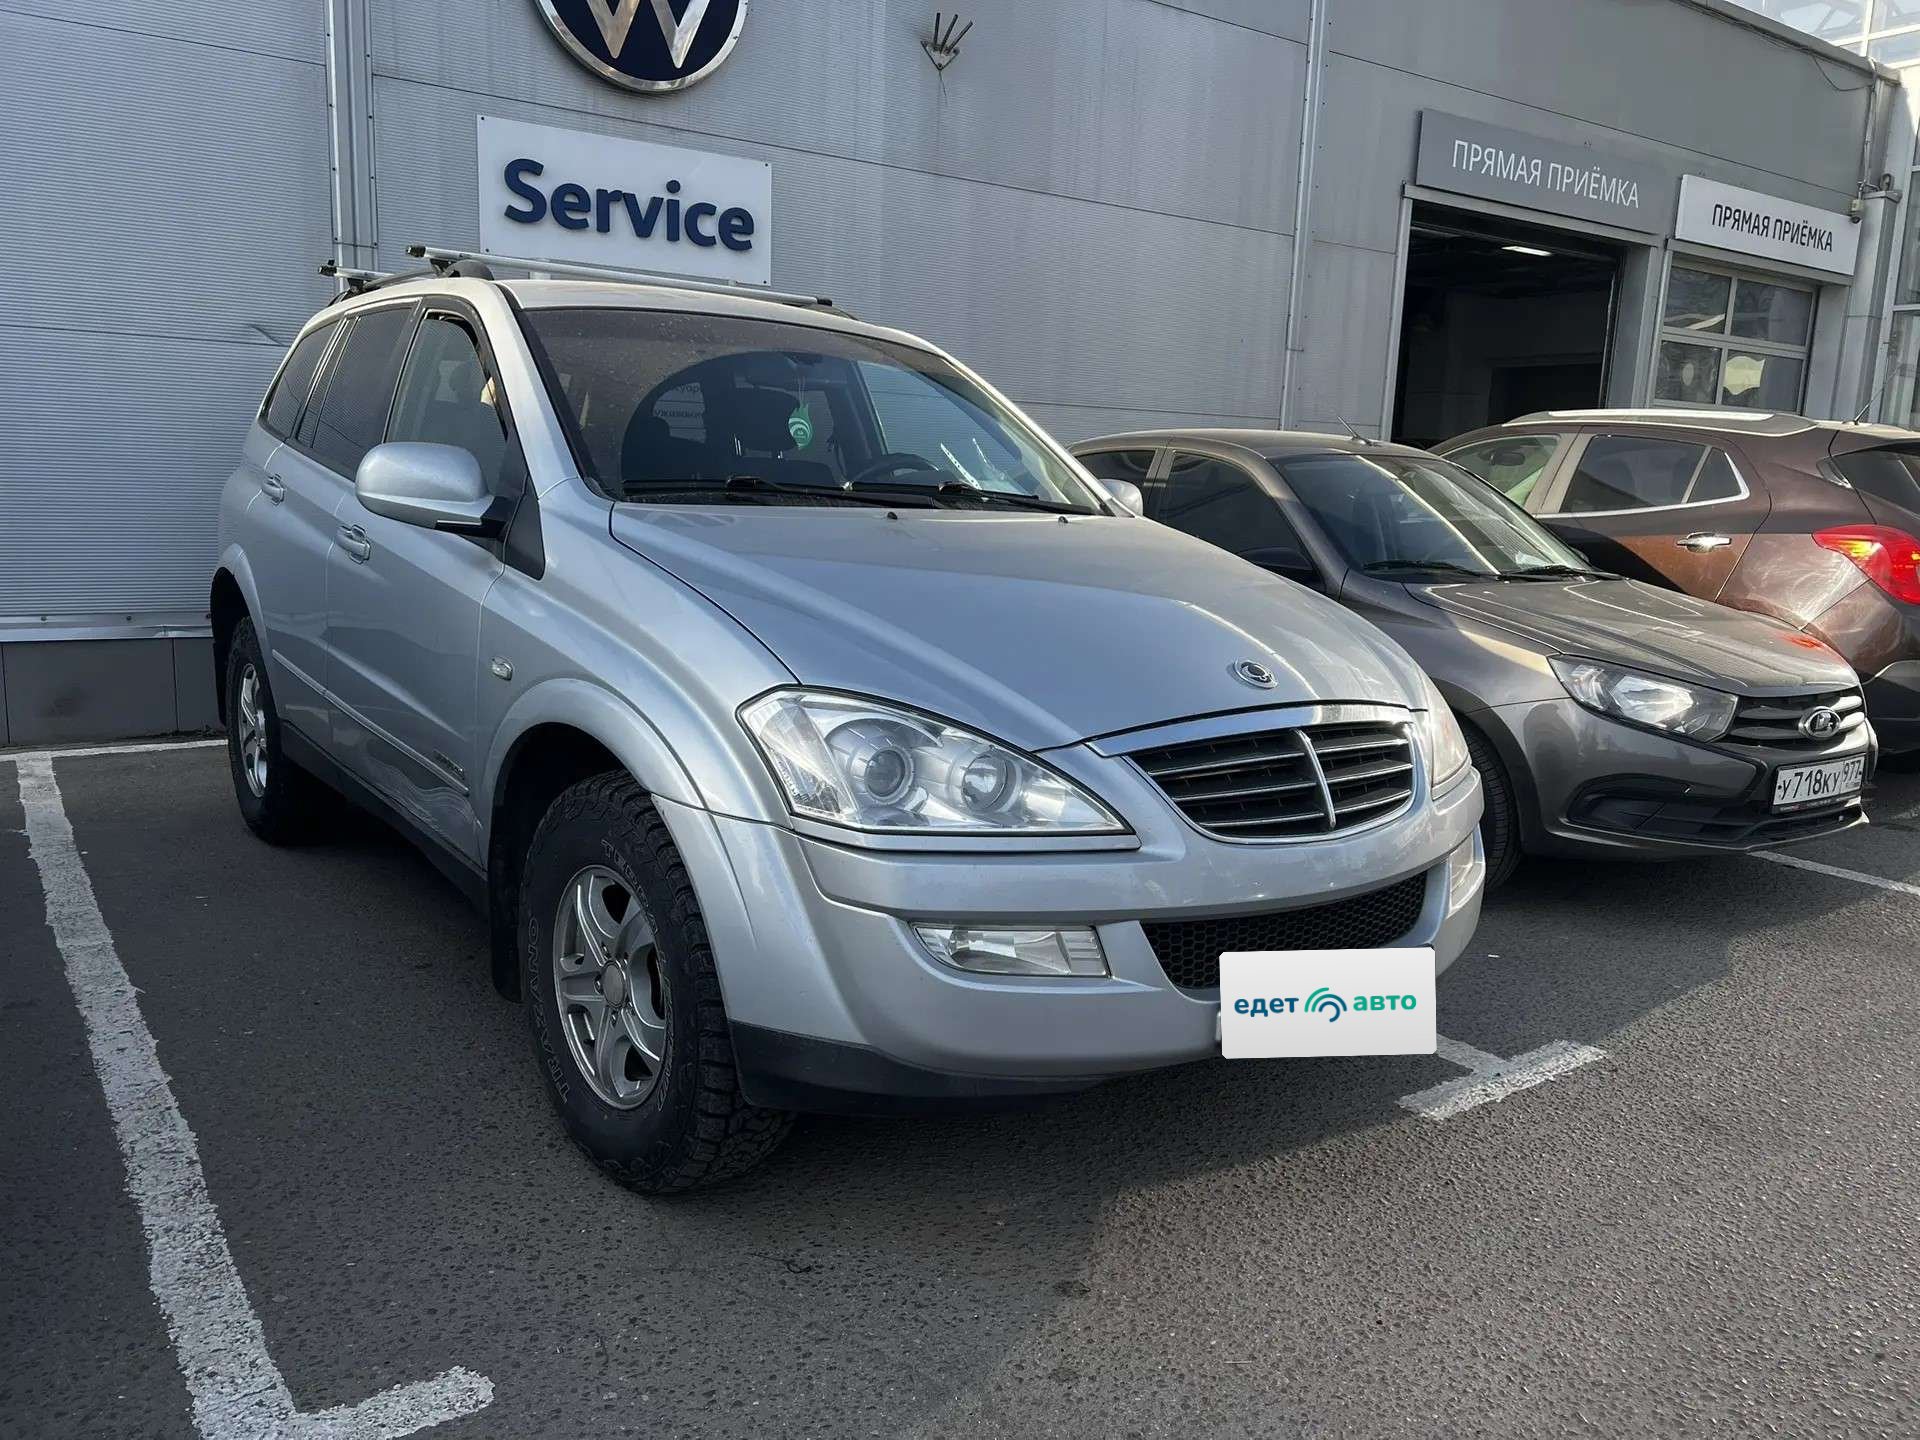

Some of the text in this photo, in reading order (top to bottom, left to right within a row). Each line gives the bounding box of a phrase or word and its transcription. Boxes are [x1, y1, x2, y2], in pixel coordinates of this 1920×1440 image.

[503, 158, 755, 252] Service
[1452, 139, 1640, 209] ПРЯМАЯ ПРИЁМКА
[1712, 203, 1833, 253] ПРЯМАЯ ПРИЁМКА
